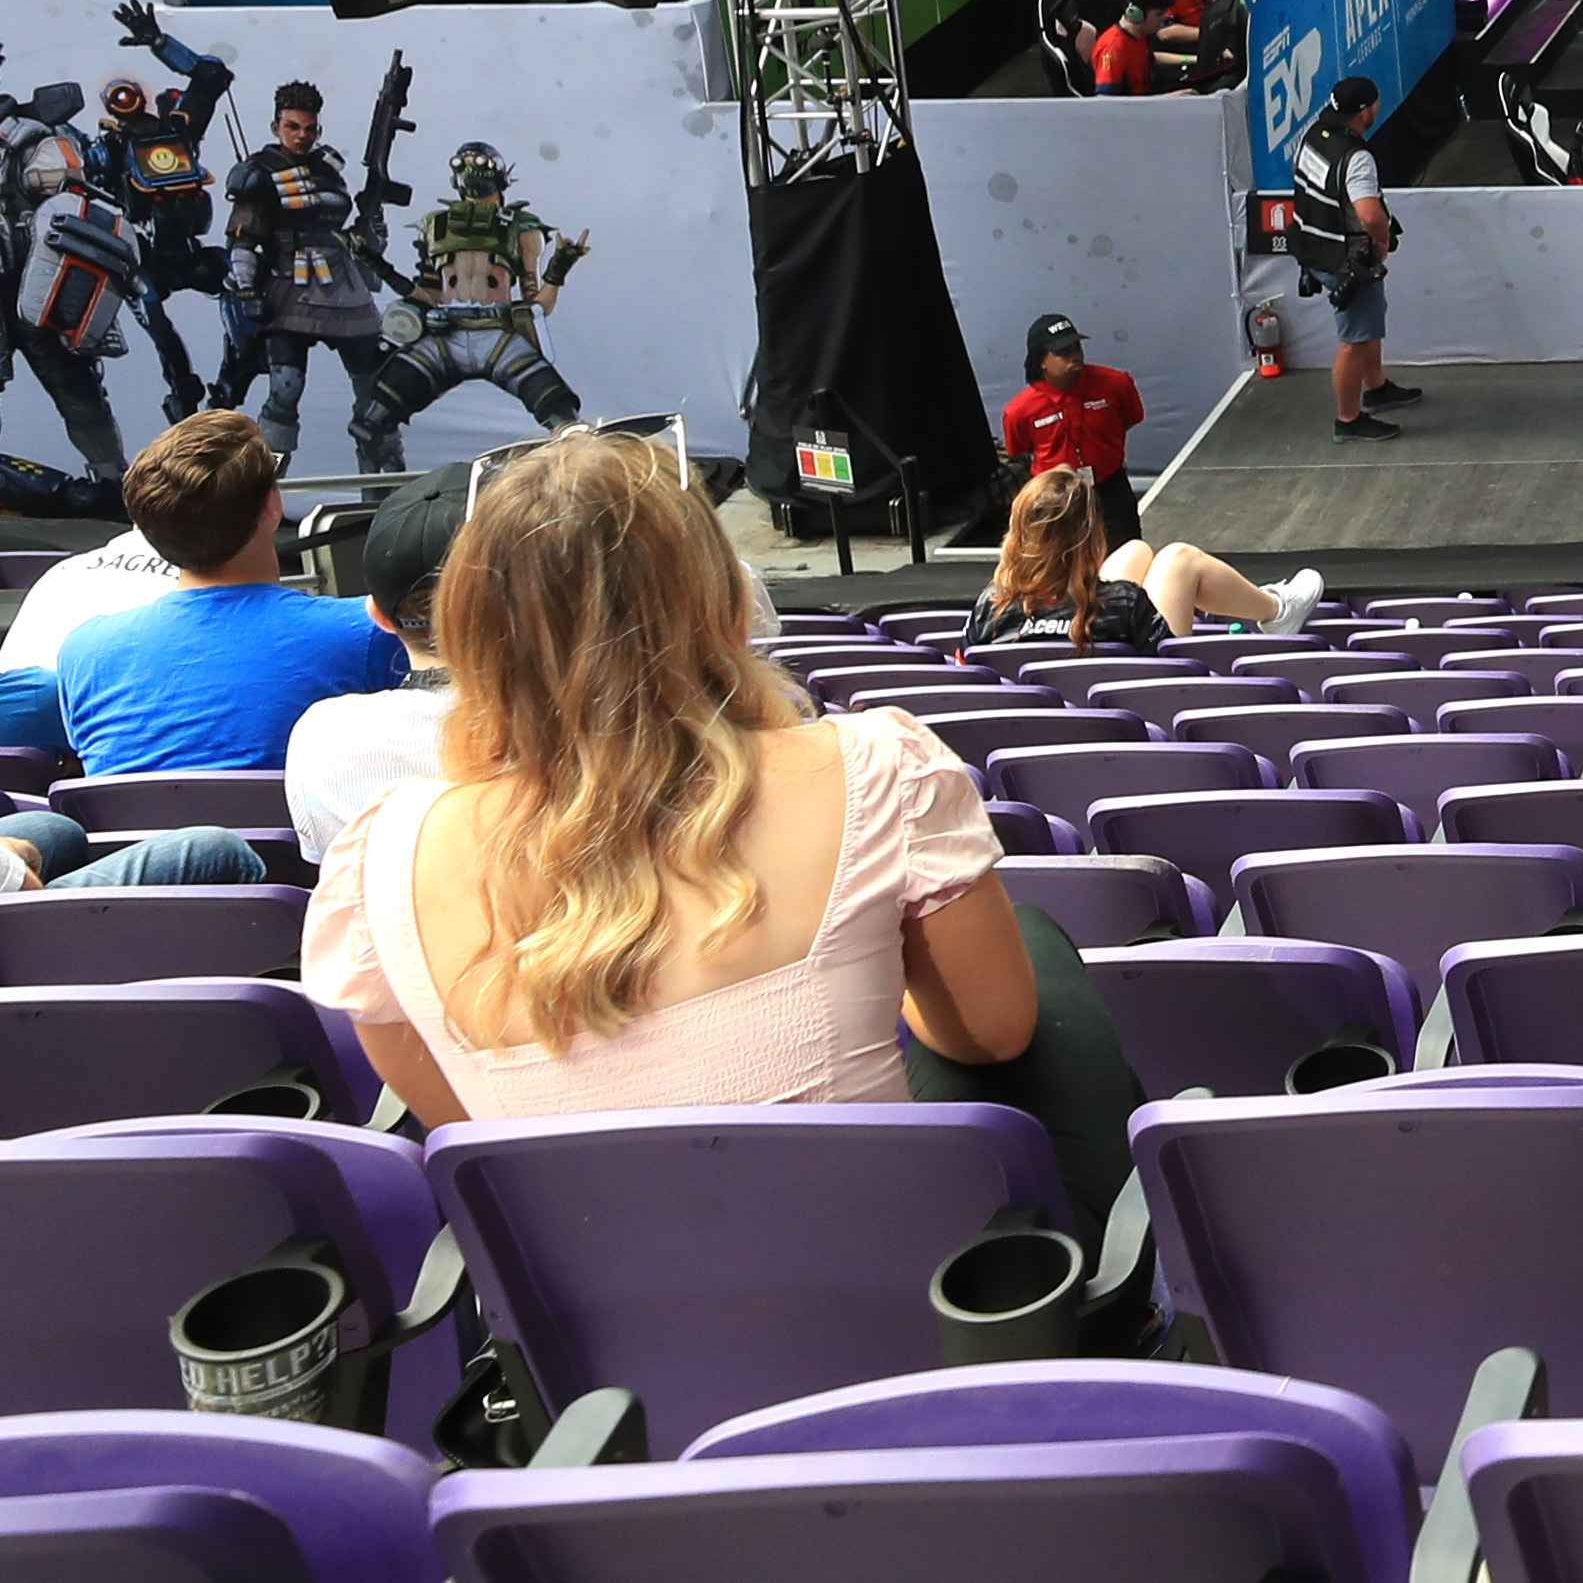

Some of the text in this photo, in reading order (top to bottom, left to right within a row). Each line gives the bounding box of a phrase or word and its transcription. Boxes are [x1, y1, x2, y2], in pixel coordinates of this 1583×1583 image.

[1262, 25, 1291, 71] ESPN
[1356, 25, 1383, 65] LEGENDS
[1262, 27, 1323, 154] EXP
